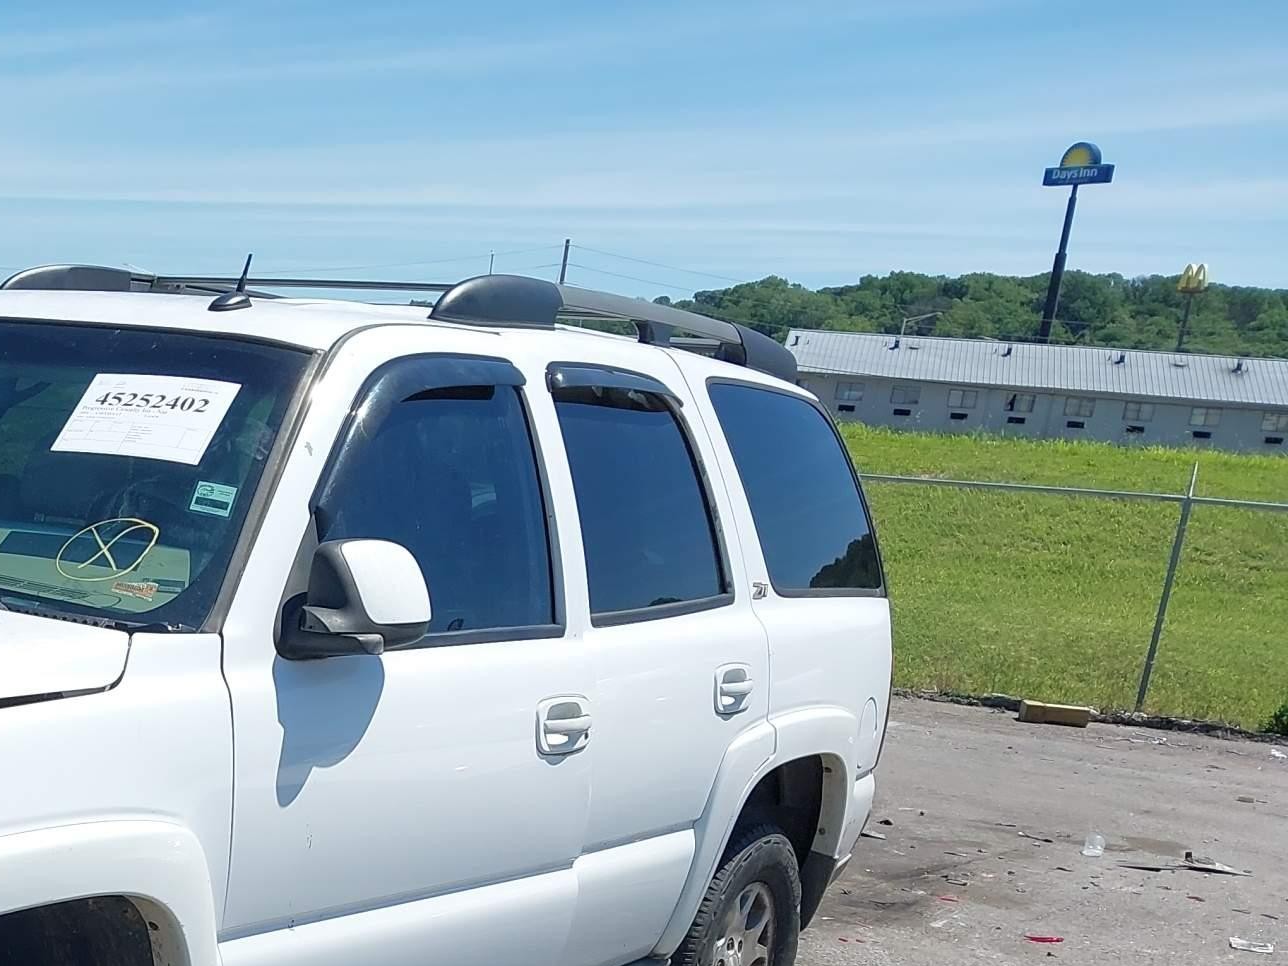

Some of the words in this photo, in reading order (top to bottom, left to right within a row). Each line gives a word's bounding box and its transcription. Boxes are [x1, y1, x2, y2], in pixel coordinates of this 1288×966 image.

[1052, 168, 1078, 180] Days
[1079, 167, 1098, 177] Inn
[95, 391, 210, 413] 45252402
